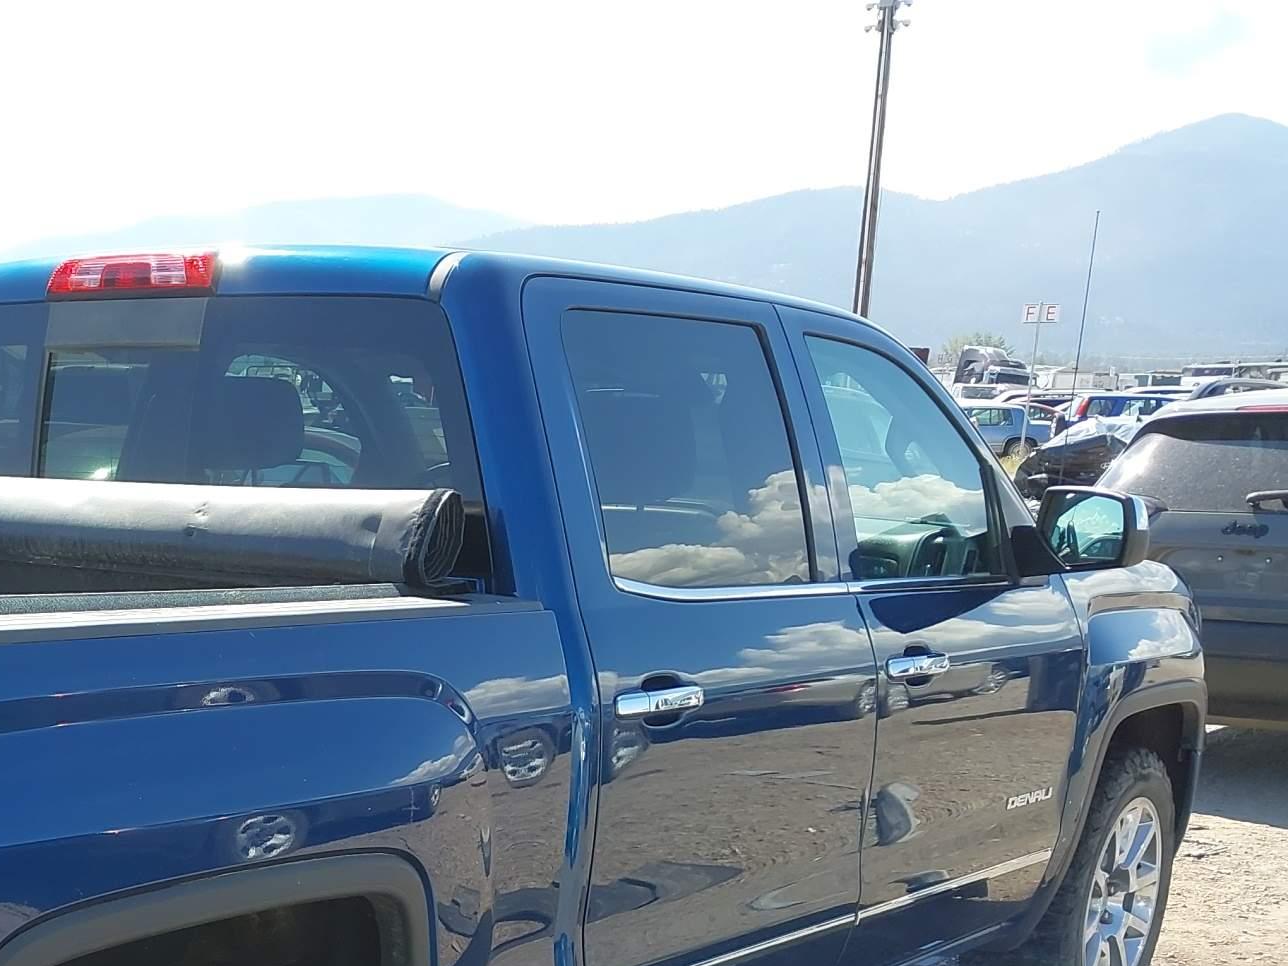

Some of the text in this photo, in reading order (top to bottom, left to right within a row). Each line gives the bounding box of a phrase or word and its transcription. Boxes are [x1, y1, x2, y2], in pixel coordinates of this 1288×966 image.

[1025, 305, 1057, 321] F E
[1006, 786, 1053, 811] DENALI
